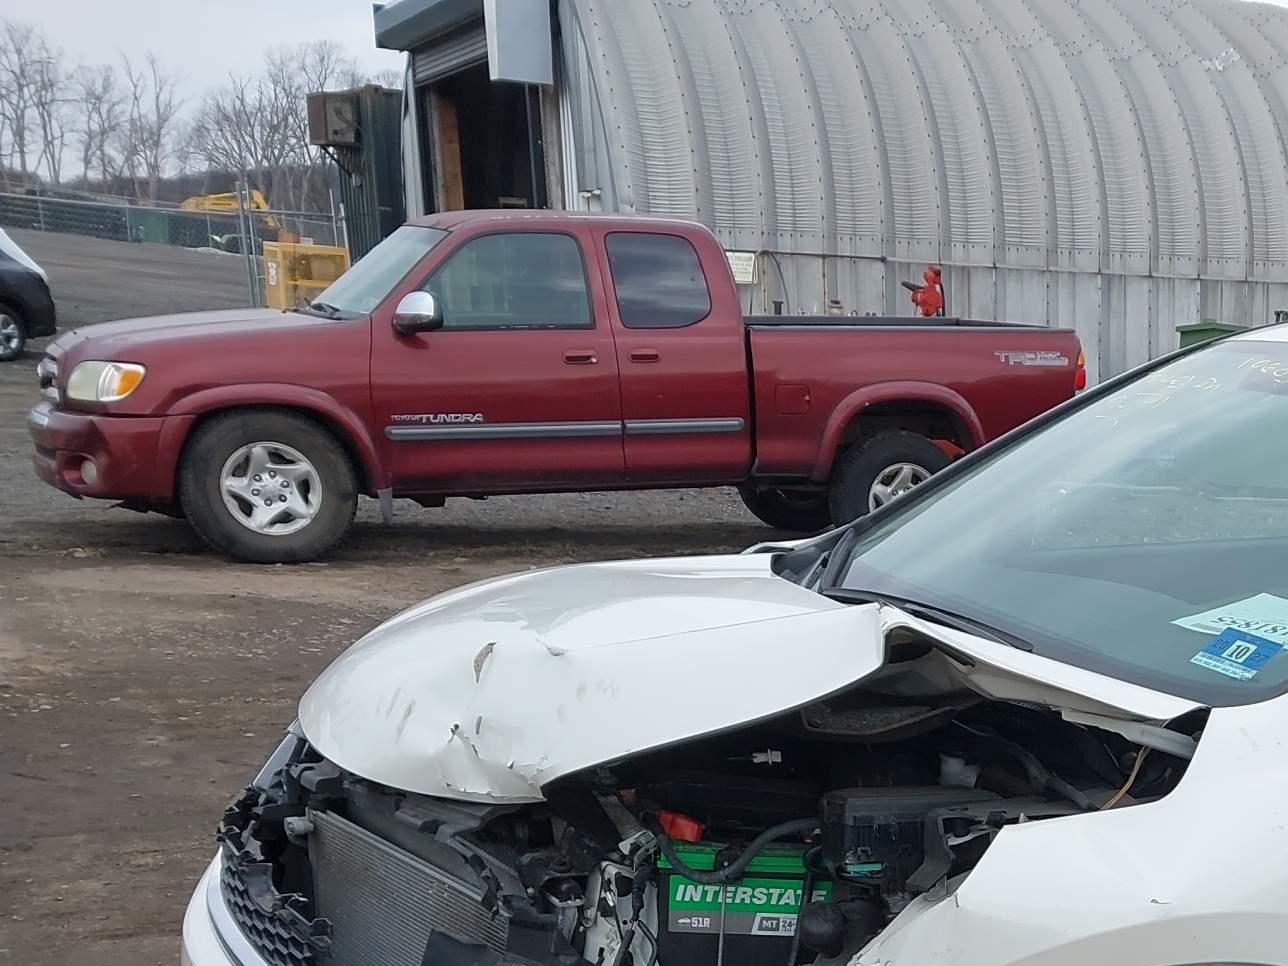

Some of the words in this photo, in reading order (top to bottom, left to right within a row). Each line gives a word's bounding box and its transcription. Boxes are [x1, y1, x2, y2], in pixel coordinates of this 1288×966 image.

[418, 413, 483, 422] TUNDRA
[1225, 644, 1250, 660] 10
[762, 919, 778, 929] MT
